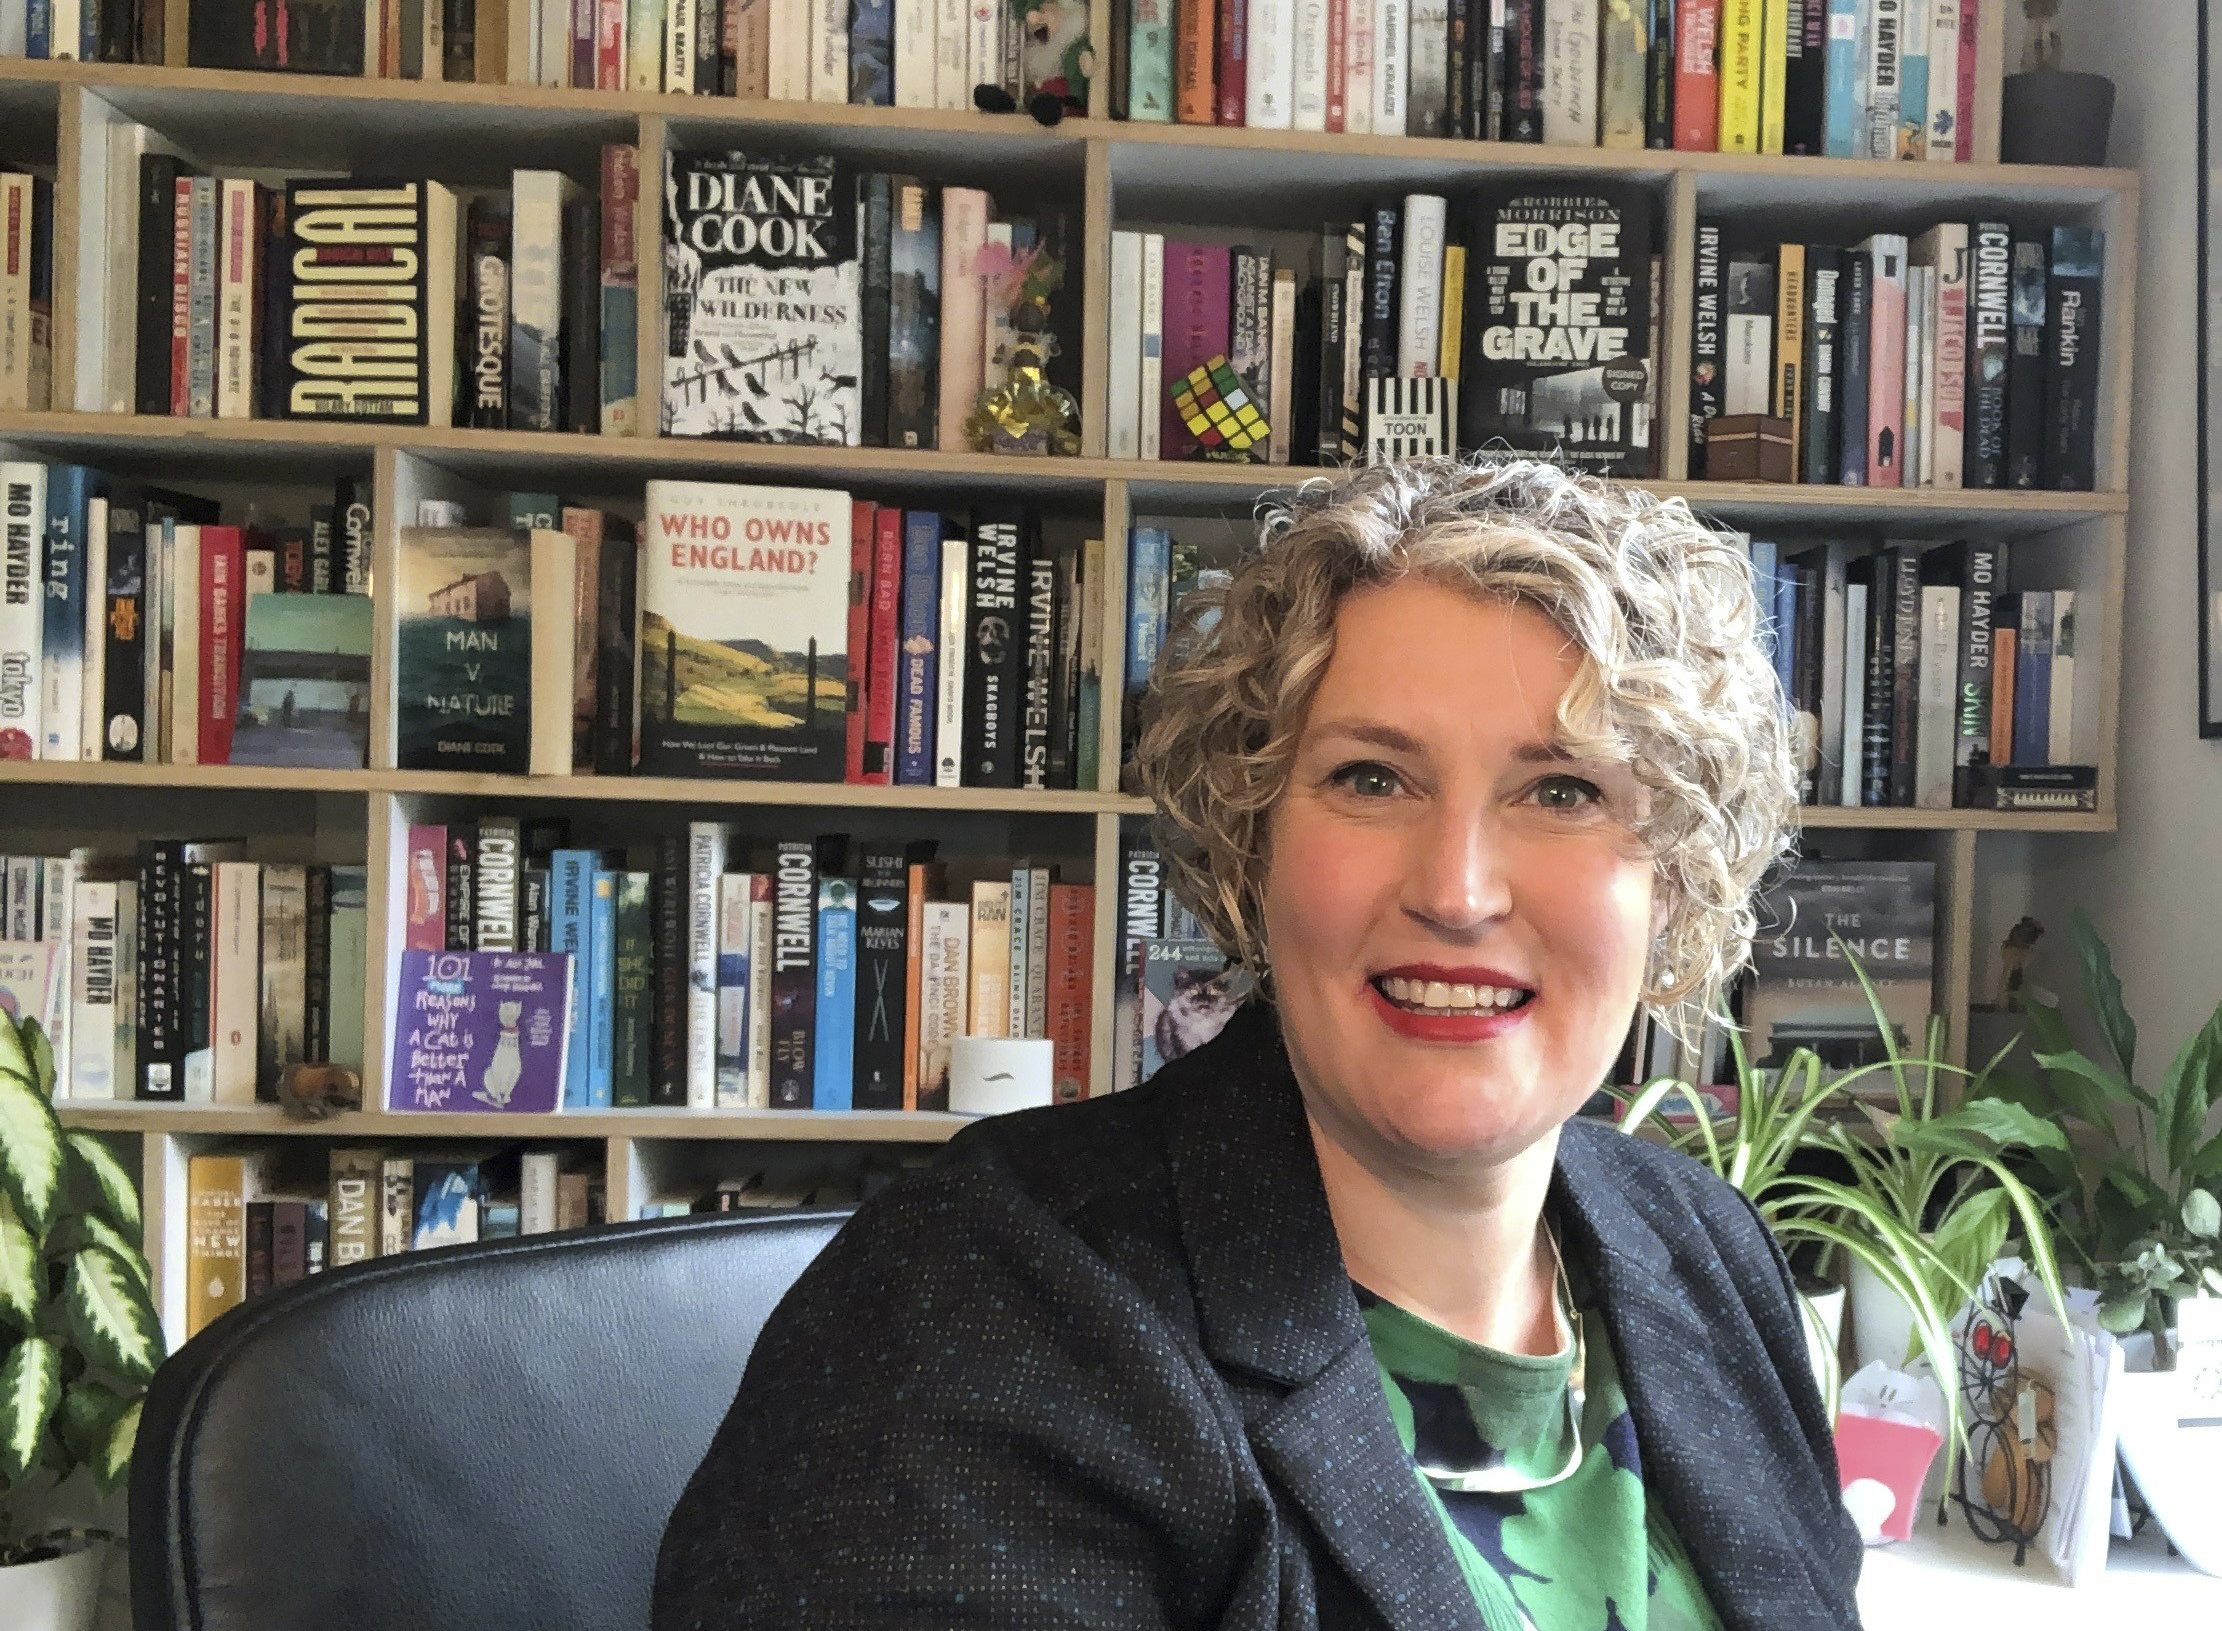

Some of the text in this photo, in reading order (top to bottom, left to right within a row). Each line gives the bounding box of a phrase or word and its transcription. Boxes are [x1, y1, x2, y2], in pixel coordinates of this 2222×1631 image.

[674, 32, 687, 78] BEATTY
[1383, 4, 1397, 117] GABRIEL KRAUZE
[1736, 31, 1751, 89] PARTY
[1876, 18, 1897, 86] HAYDER
[687, 172, 833, 217] DIANE
[1497, 209, 1621, 222] MORRISON
[691, 213, 828, 259] COOK
[1376, 210, 1397, 253] Ben
[1417, 215, 1437, 280] LOUISE
[1496, 223, 1621, 258] EDGE
[1526, 258, 1588, 292] OF
[1698, 226, 1720, 288] IRVINE
[291, 183, 418, 415] RADICAL
[715, 276, 812, 296] THE NEW
[1236, 255, 1248, 353] BACKGROUND
[1373, 258, 1395, 321] Elton
[1977, 232, 2009, 349] CORNWELL
[475, 255, 504, 410] GROTESQUE
[700, 301, 848, 325] WILDERNESS
[1413, 286, 1433, 350] WELSH
[1509, 292, 1602, 327] THE
[1696, 293, 1718, 355] WELSH
[2059, 290, 2082, 366] Rankin
[1482, 325, 1629, 361] GRAVE
[1606, 369, 1645, 380] SIGNED
[1610, 381, 1640, 392] COPY
[1384, 422, 1427, 436] TOON
[660, 512, 832, 546] WHO OWNS
[47, 515, 76, 601] ring
[671, 542, 820, 576] ENGLAND?
[881, 531, 896, 574] BORN
[975, 522, 998, 609] WELSH
[996, 523, 1019, 609] IRVINE
[312, 559, 331, 594] GARL
[879, 578, 894, 611] BAD
[1898, 557, 1917, 614] LLOYD
[1, 483, 34, 718] MO HAYDER tokyo
[446, 631, 498, 651] MAN
[1961, 552, 1993, 738] MO HAYDER SKIN
[464, 662, 481, 681] V
[1023, 559, 1054, 790] IRVINE WELSH
[427, 694, 515, 716] NATURE
[907, 658, 925, 754] DEAD FAMOUS
[984, 675, 1000, 749] SKAGBOYS
[458, 864, 471, 921] EMPIRE
[564, 860, 580, 916] IRVINE
[694, 834, 712, 962] PATRICIA CORNWELL
[1012, 876, 1023, 900] JIM
[526, 914, 541, 953] Warn
[776, 853, 813, 973] CORNWELL
[1012, 908, 1023, 952] CRACE
[1824, 912, 1862, 928] THE
[930, 925, 942, 948] THE
[1029, 875, 1047, 1038] JIM CRACE QUARANT
[1148, 944, 1183, 961] 244
[1772, 936, 1911, 960] SILENCE
[85, 916, 114, 1005] MO HAYDER
[422, 954, 474, 982] 101
[930, 952, 941, 970] DA
[1012, 964, 1022, 1001] BEING
[943, 937, 961, 1039] DAN BROWN
[792, 1030, 806, 1072] BLOW
[337, 1179, 366, 1236] DAN
